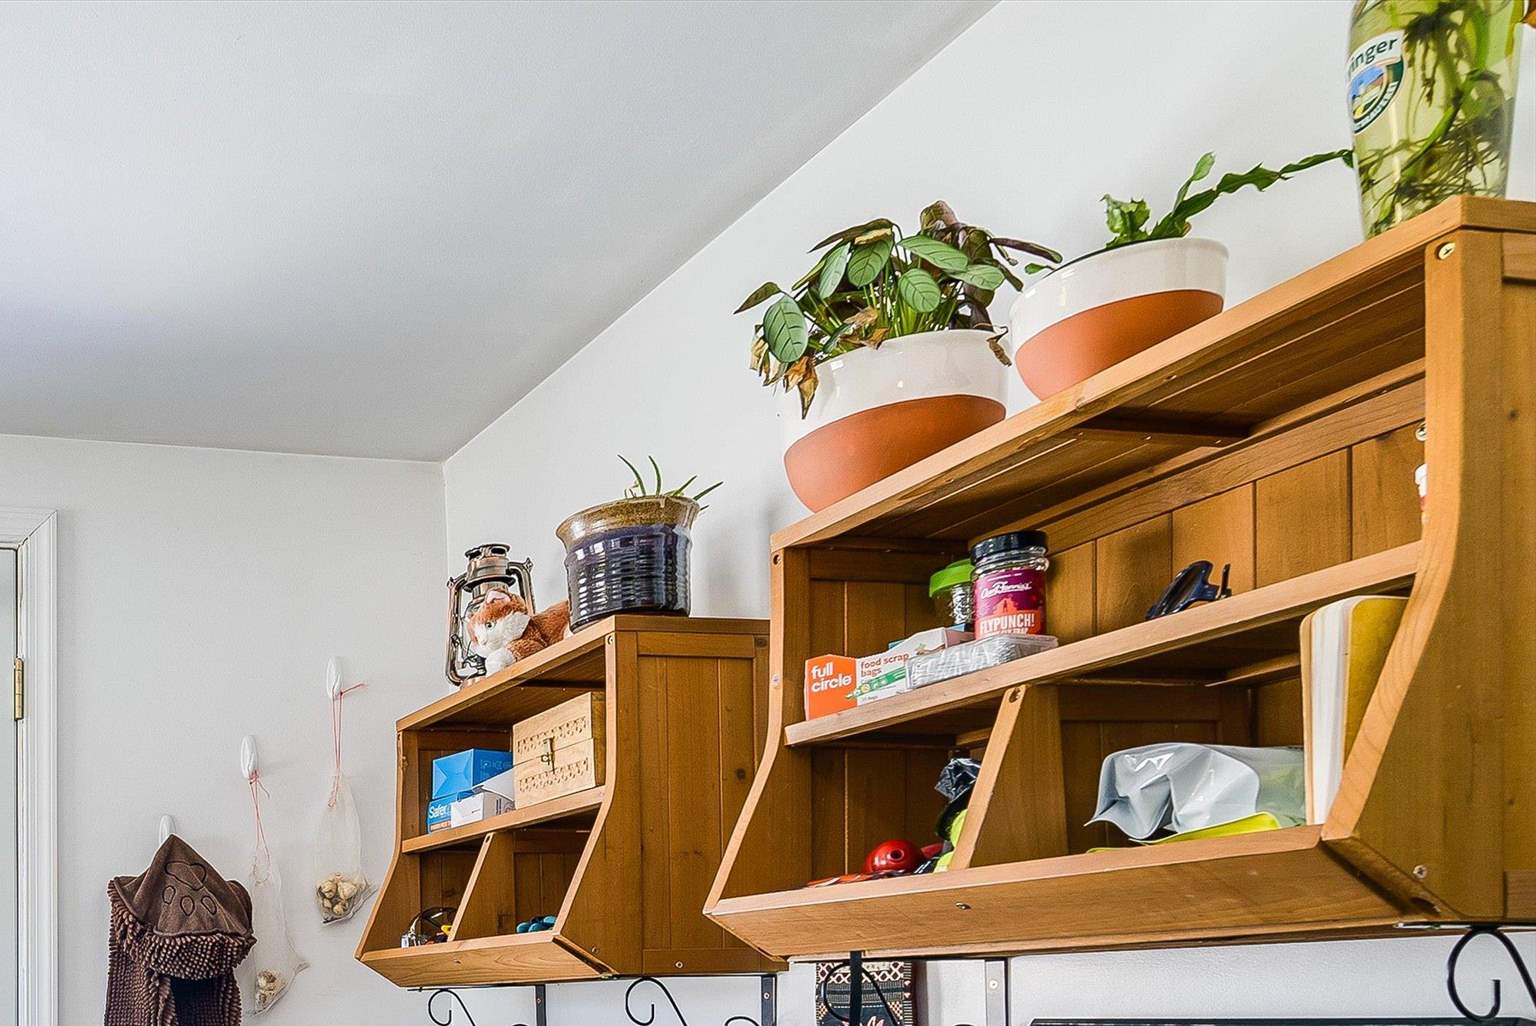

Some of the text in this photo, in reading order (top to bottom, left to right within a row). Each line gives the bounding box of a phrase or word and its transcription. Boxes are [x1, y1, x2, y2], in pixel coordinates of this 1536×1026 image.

[979, 613, 1035, 636] FLYPUNCH!
[811, 661, 834, 679] full
[861, 653, 910, 670] food scrap
[861, 667, 882, 679] bags
[811, 675, 852, 692] circle
